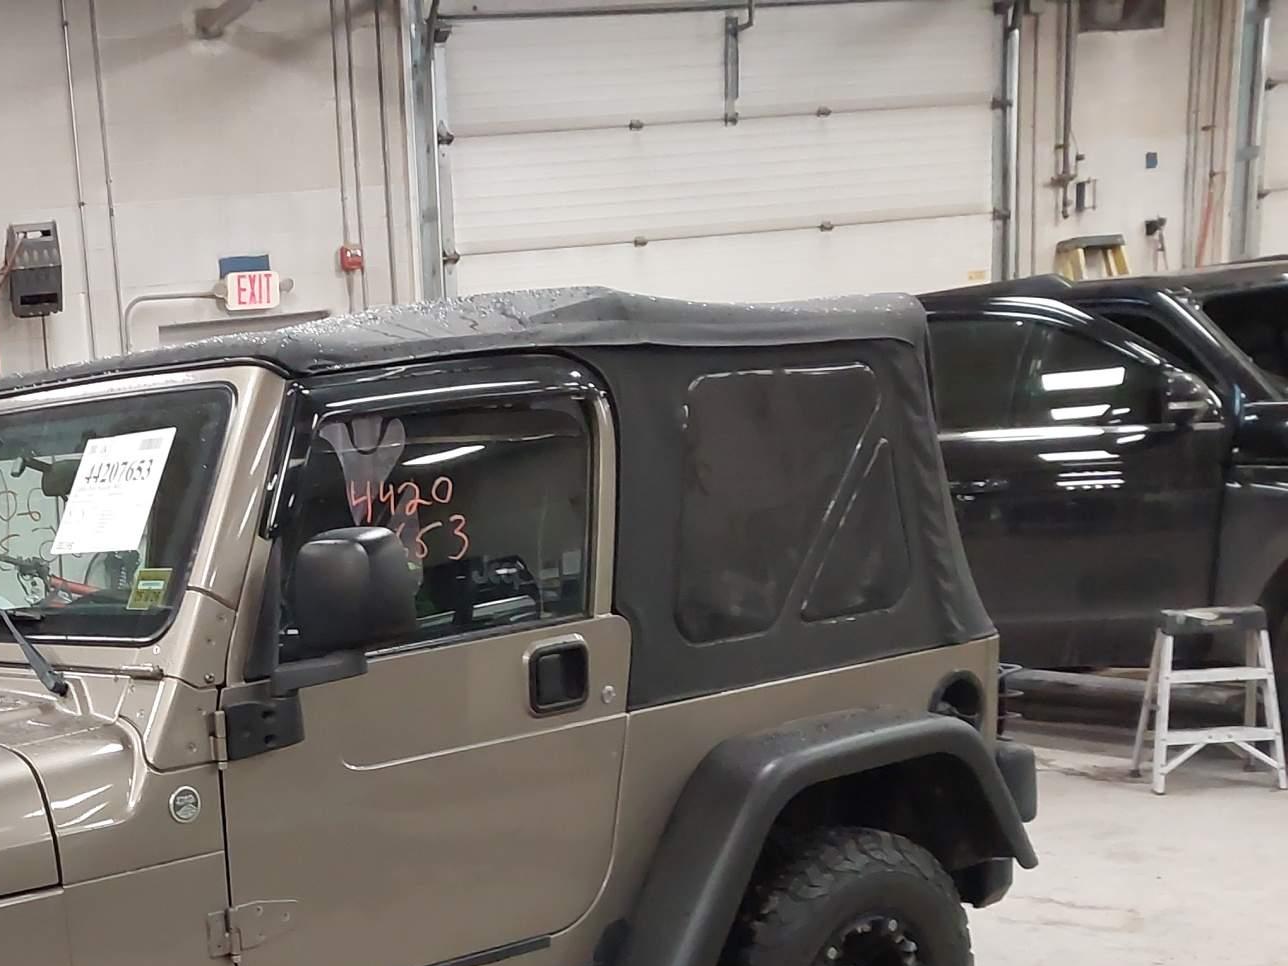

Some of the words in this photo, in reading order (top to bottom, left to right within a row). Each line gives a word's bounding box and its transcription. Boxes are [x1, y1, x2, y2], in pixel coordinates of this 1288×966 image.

[237, 273, 272, 305] EXIT
[84, 458, 154, 484] 44207653
[352, 475, 453, 523] 4420
